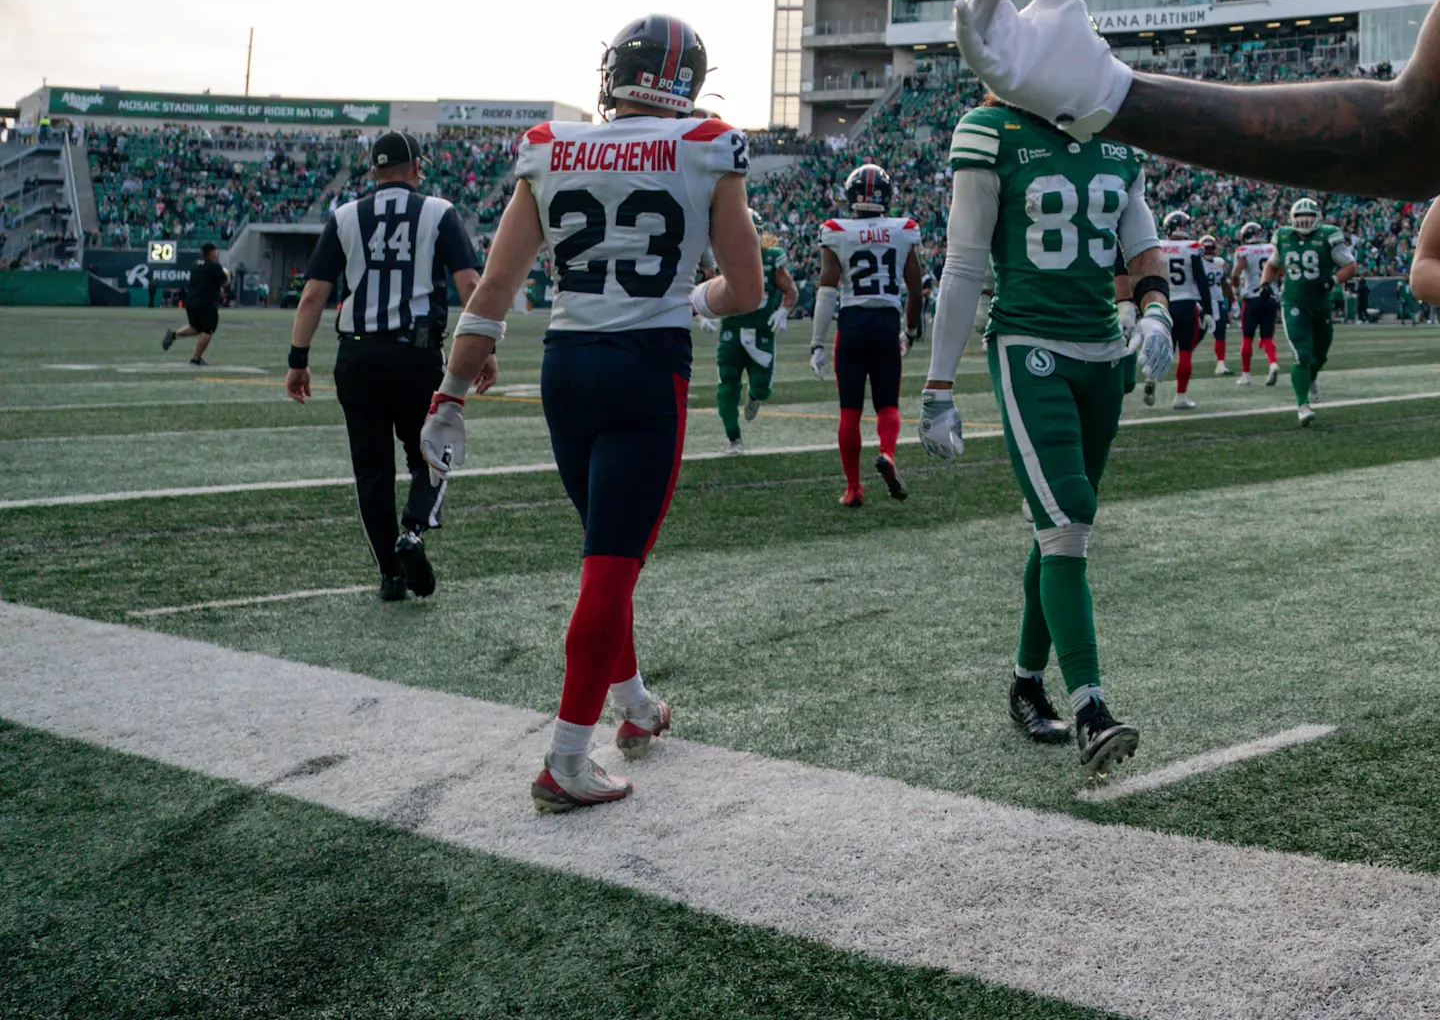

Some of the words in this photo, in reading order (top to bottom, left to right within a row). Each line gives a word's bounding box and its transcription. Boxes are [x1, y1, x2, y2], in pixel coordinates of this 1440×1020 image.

[1145, 10, 1206, 26] PLATINUM
[658, 78, 674, 89] 80
[61, 92, 105, 105] Mosaic
[628, 89, 688, 108] ALOUETTES
[118, 100, 160, 112] MOSAIC
[162, 101, 209, 114] STADIUM
[215, 103, 245, 116] HOME
[248, 105, 262, 116] OF
[264, 106, 295, 118] RIDER
[296, 107, 334, 119] NATION
[343, 104, 380, 116] Mosaic
[482, 107, 513, 118] RIDER
[514, 108, 550, 120] STORE
[550, 140, 677, 173] BEAUCHEMIN
[731, 133, 749, 170] 2
[1025, 174, 1128, 270] 89
[368, 221, 411, 261] 44
[548, 189, 686, 298] 23
[859, 229, 890, 244] CALLIS
[151, 243, 173, 261] 20
[152, 270, 191, 281] REGIN
[849, 247, 900, 296] 21
